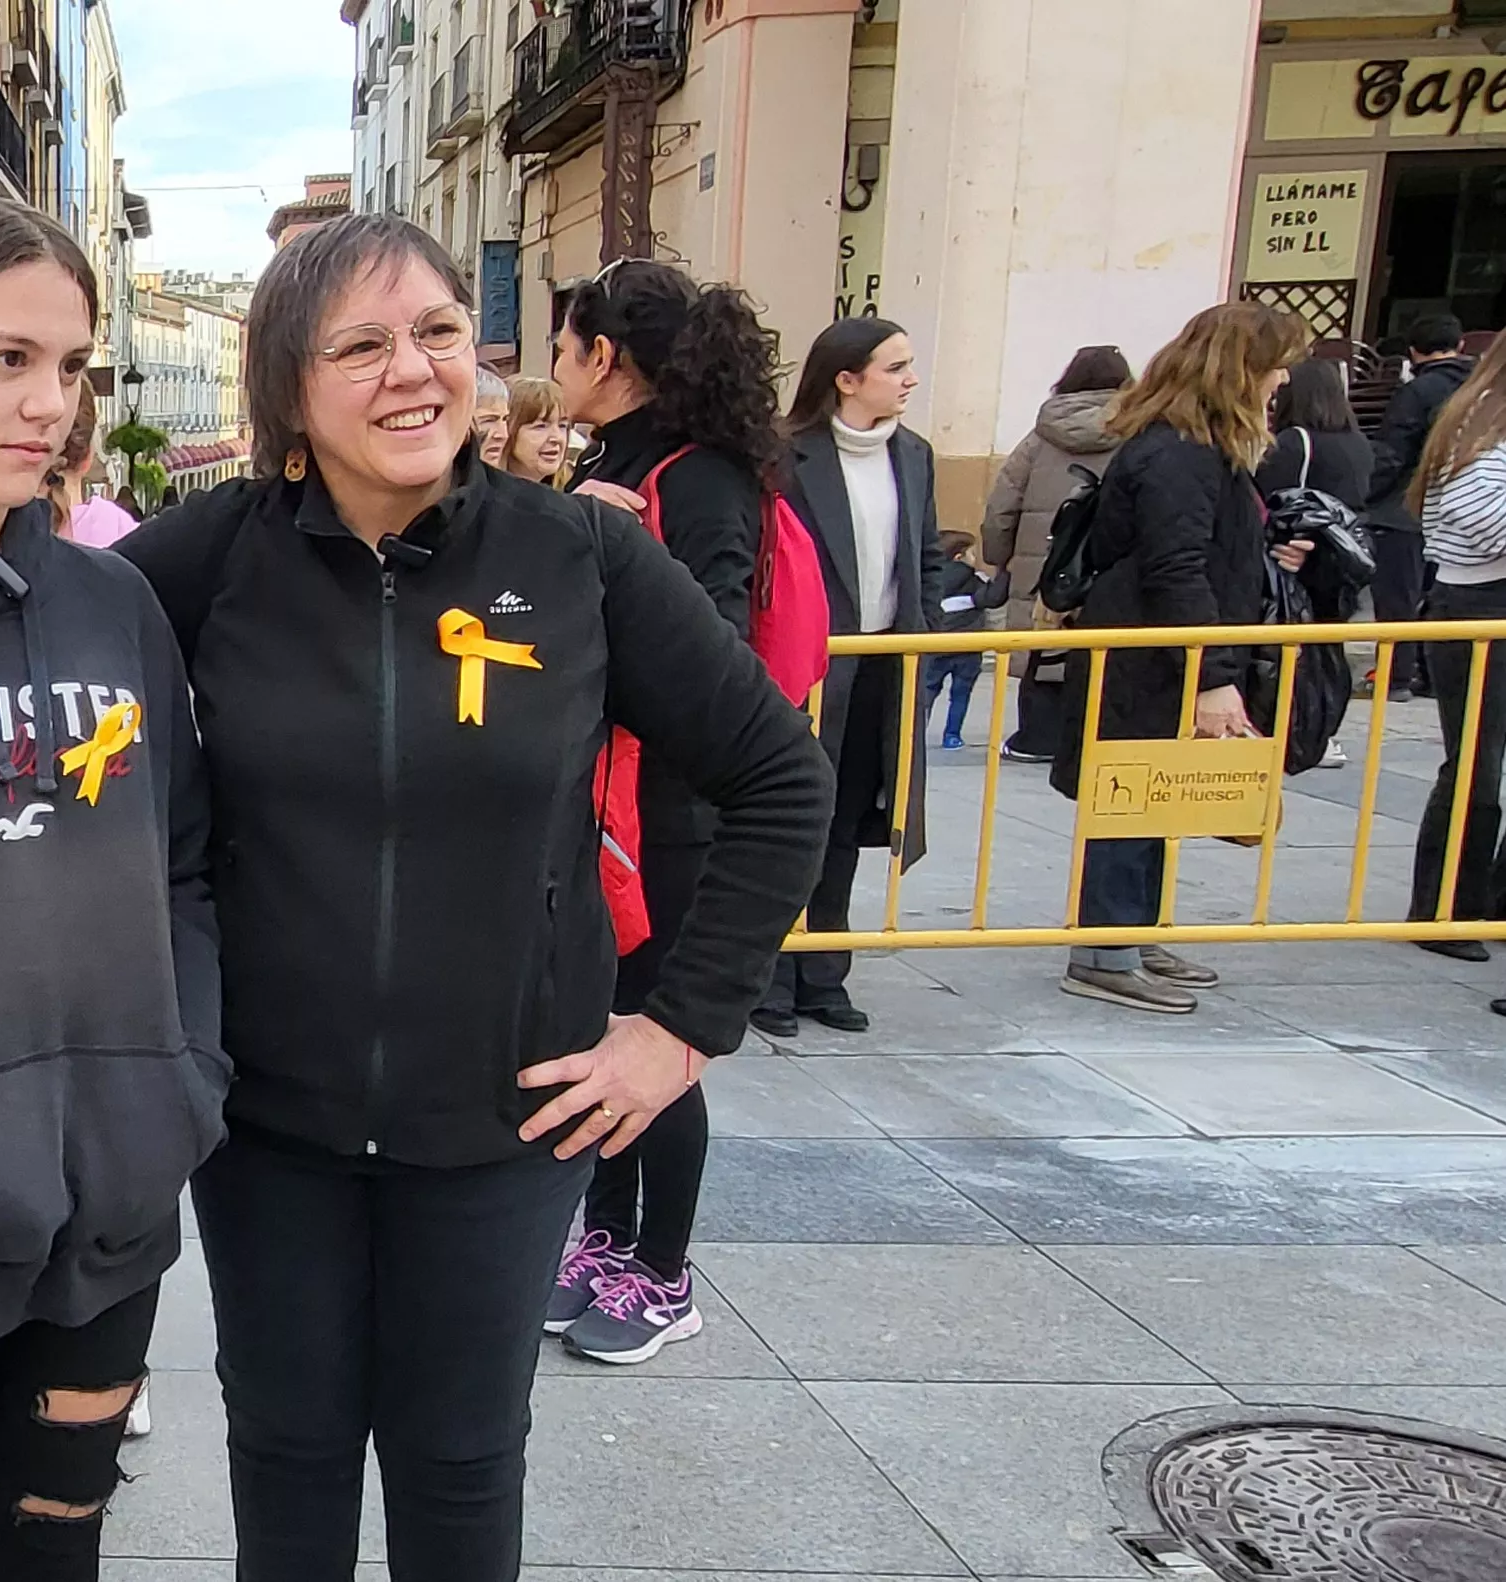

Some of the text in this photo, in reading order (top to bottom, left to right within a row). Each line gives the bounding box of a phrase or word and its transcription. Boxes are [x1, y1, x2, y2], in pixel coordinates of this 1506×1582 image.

[1266, 178, 1357, 202] LLÁMAME
[1270, 210, 1318, 227] PERO
[1266, 231, 1330, 254] SIN LL
[1150, 789, 1244, 803] de Huesca
